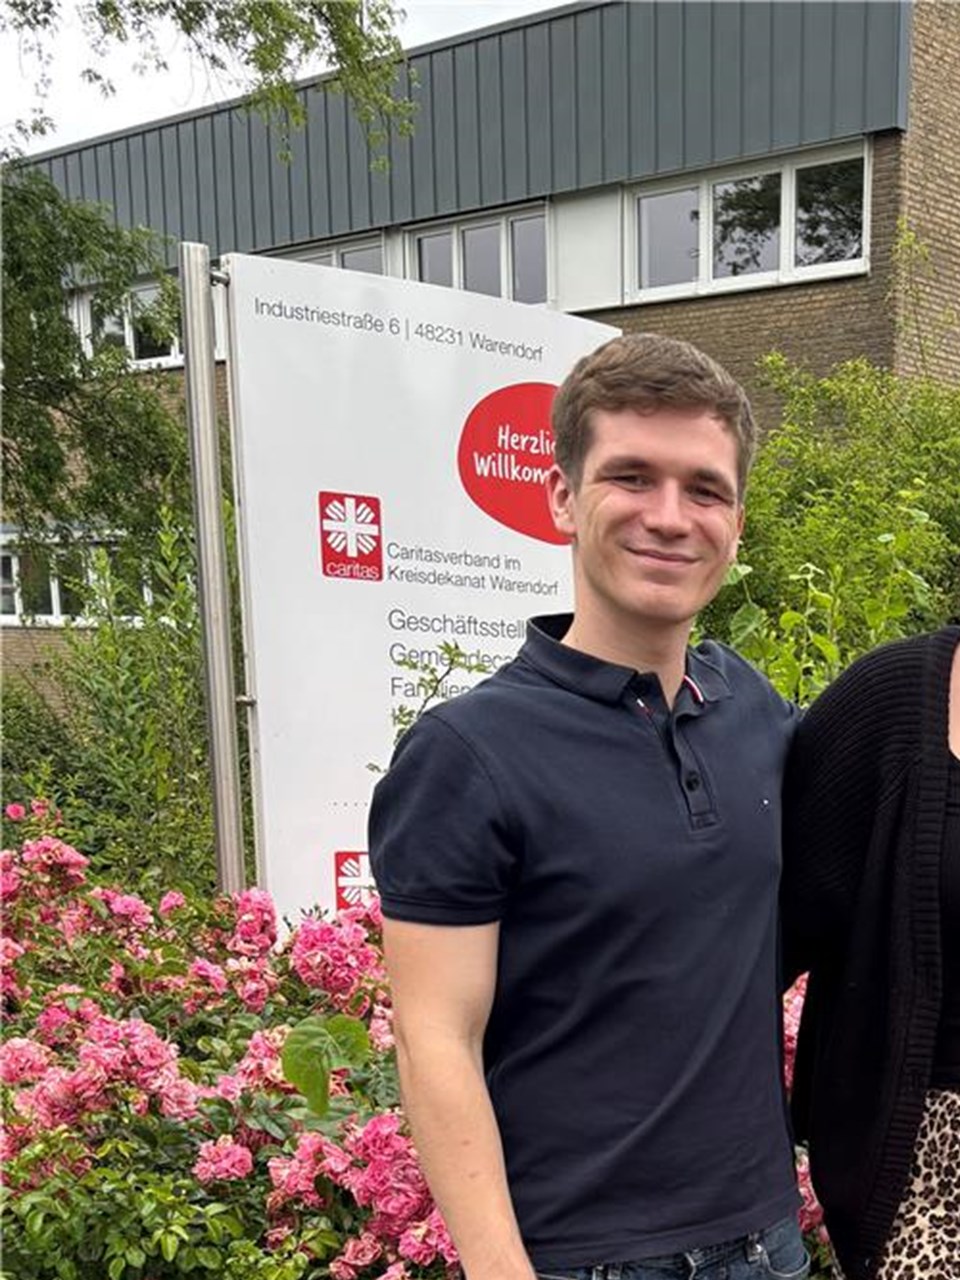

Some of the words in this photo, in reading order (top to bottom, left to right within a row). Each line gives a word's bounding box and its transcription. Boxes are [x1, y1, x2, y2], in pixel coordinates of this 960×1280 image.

[255, 297, 384, 333] Industriestraße
[389, 319, 400, 335] 6
[414, 323, 463, 346] 48231
[469, 332, 542, 361] Warendorf
[326, 561, 380, 580] caritas
[387, 542, 501, 569] Caritasverband
[504, 555, 521, 571] im
[388, 565, 485, 590] Kreisdekanat
[490, 575, 559, 596] Warendorf
